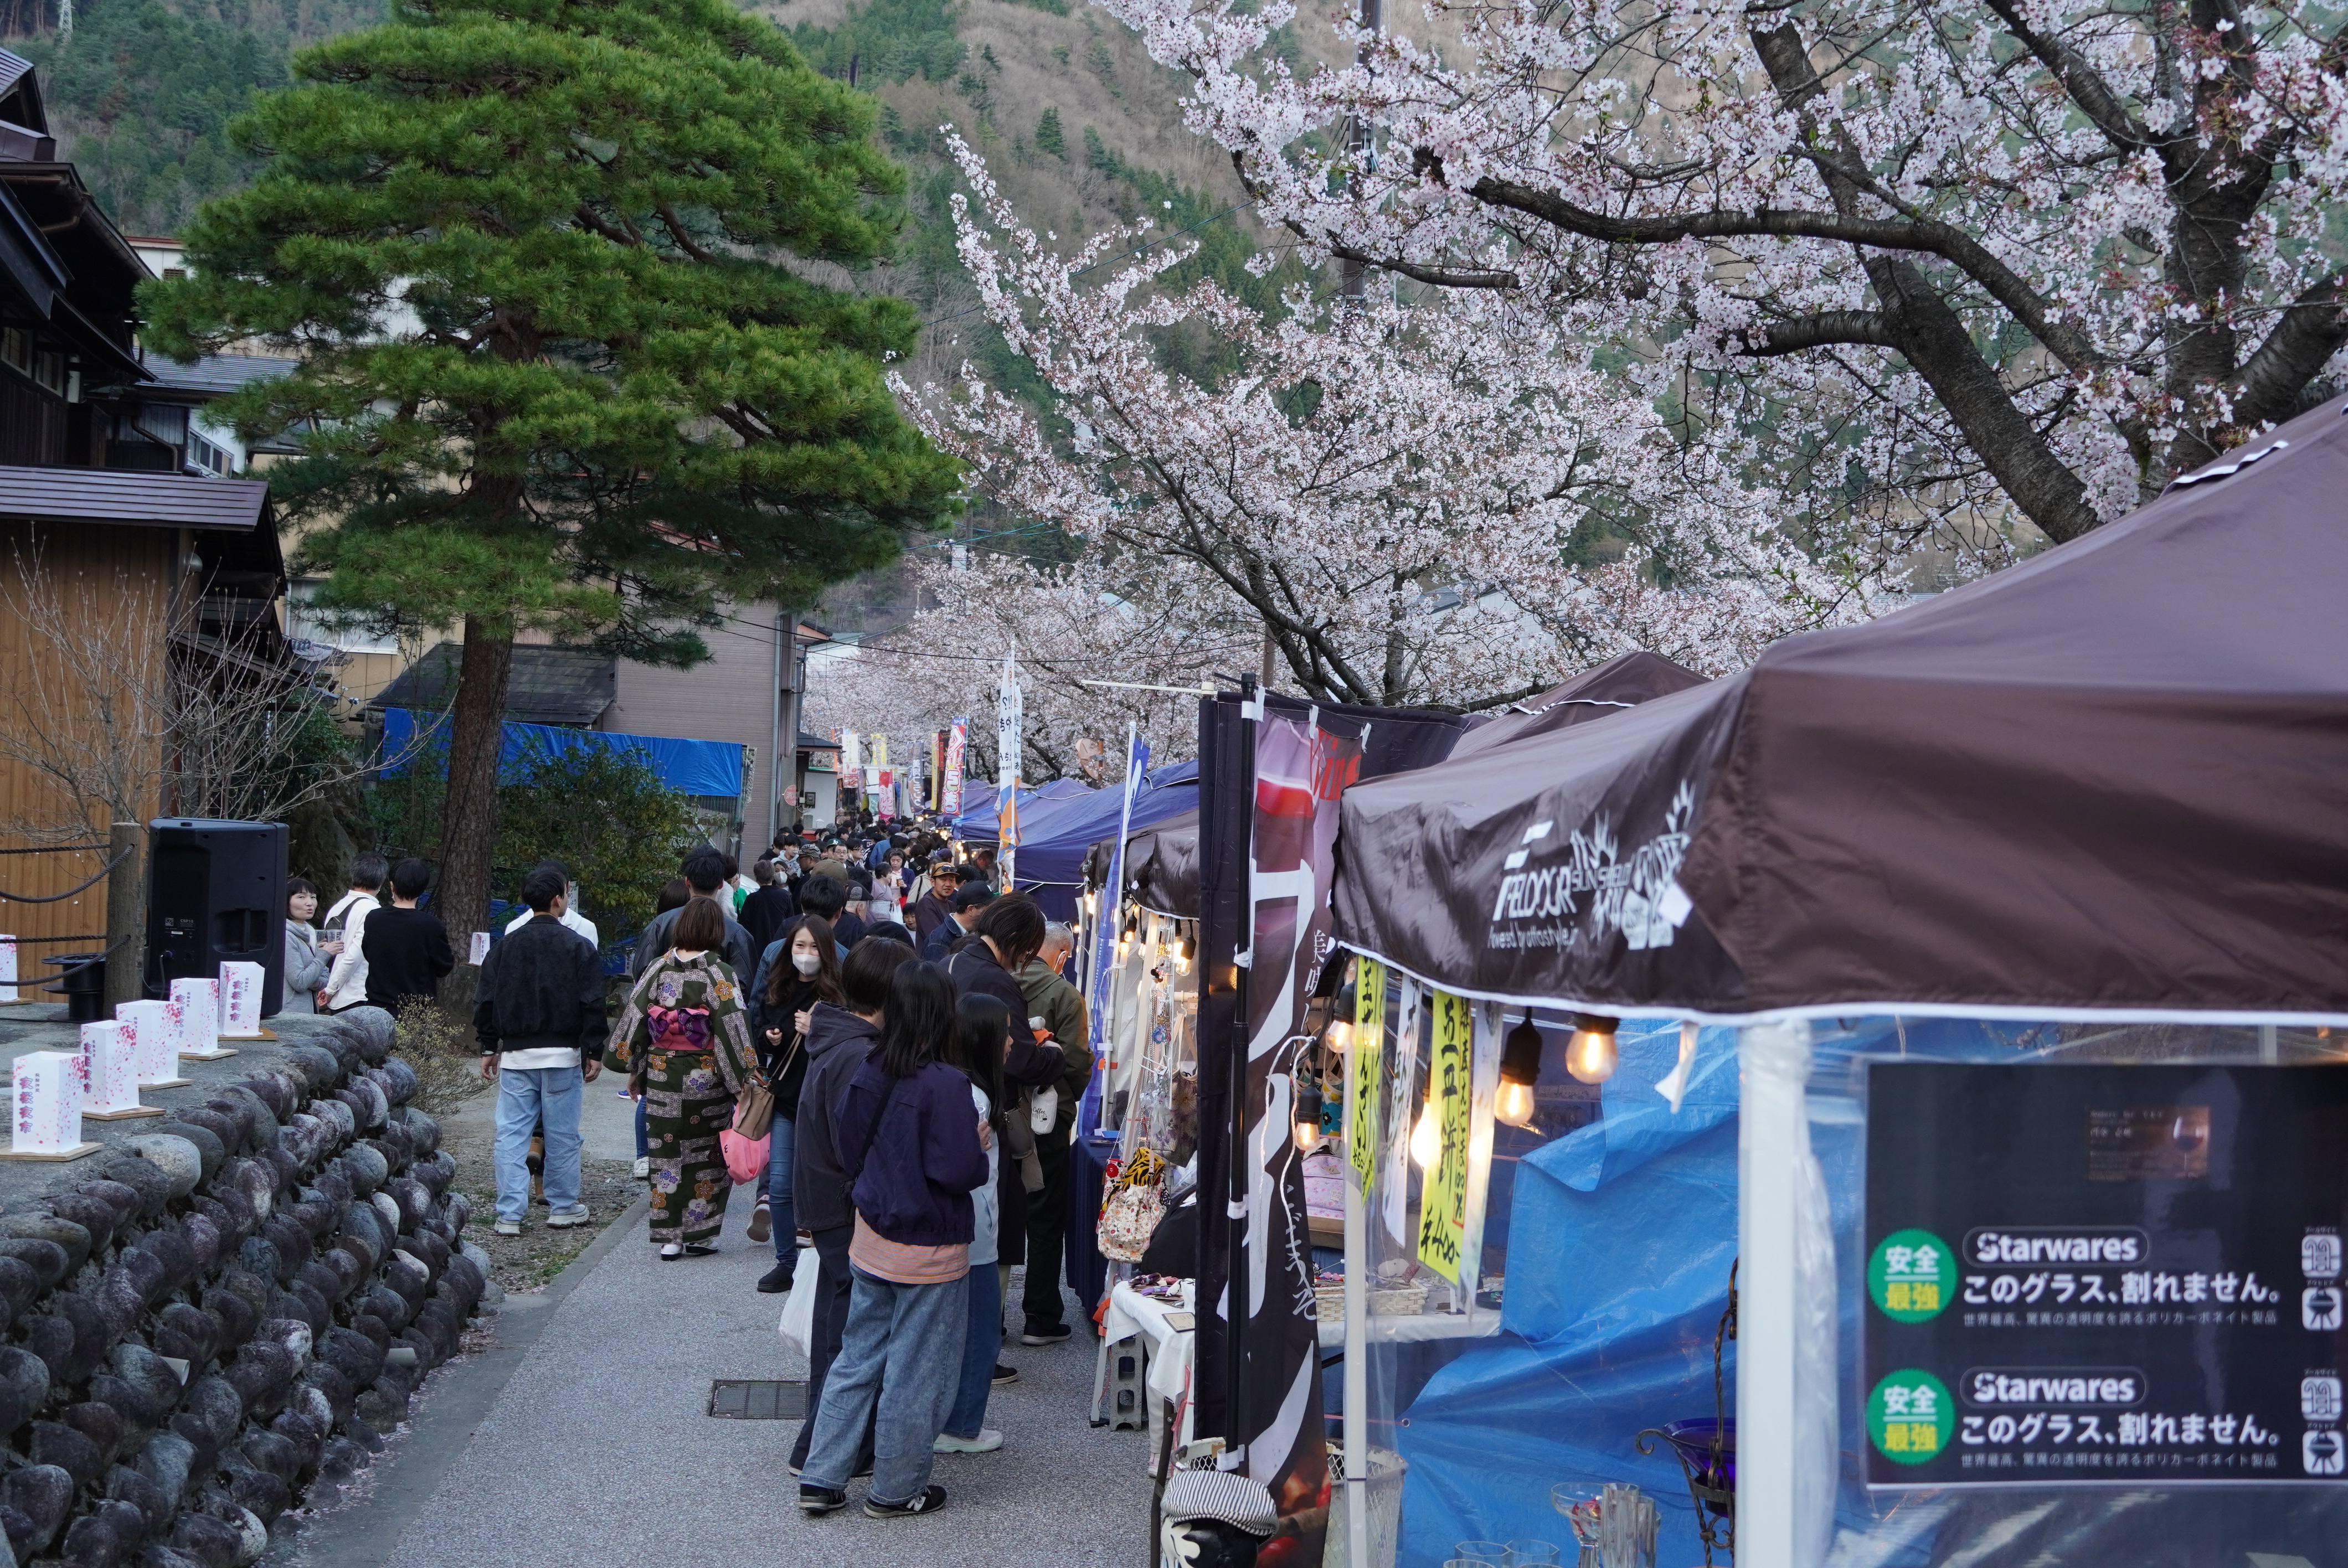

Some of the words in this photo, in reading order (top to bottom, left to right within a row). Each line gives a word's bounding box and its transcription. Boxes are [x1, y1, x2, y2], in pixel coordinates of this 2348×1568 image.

[230, 980, 244, 1022] 夜桜夜市
[19, 1076, 34, 1134] 夜桜夜市
[1884, 1245, 1940, 1275] 安全
[1976, 1232, 2138, 1263] Starwares
[1885, 1282, 1940, 1312] 最強
[1963, 1272, 2280, 1306] このグラス、割れません。
[1883, 1385, 1938, 1415] 安全
[1973, 1373, 2135, 1404] Starwares
[1883, 1423, 1938, 1452] 最強
[1961, 1413, 2280, 1446] このグラス、割れません。
